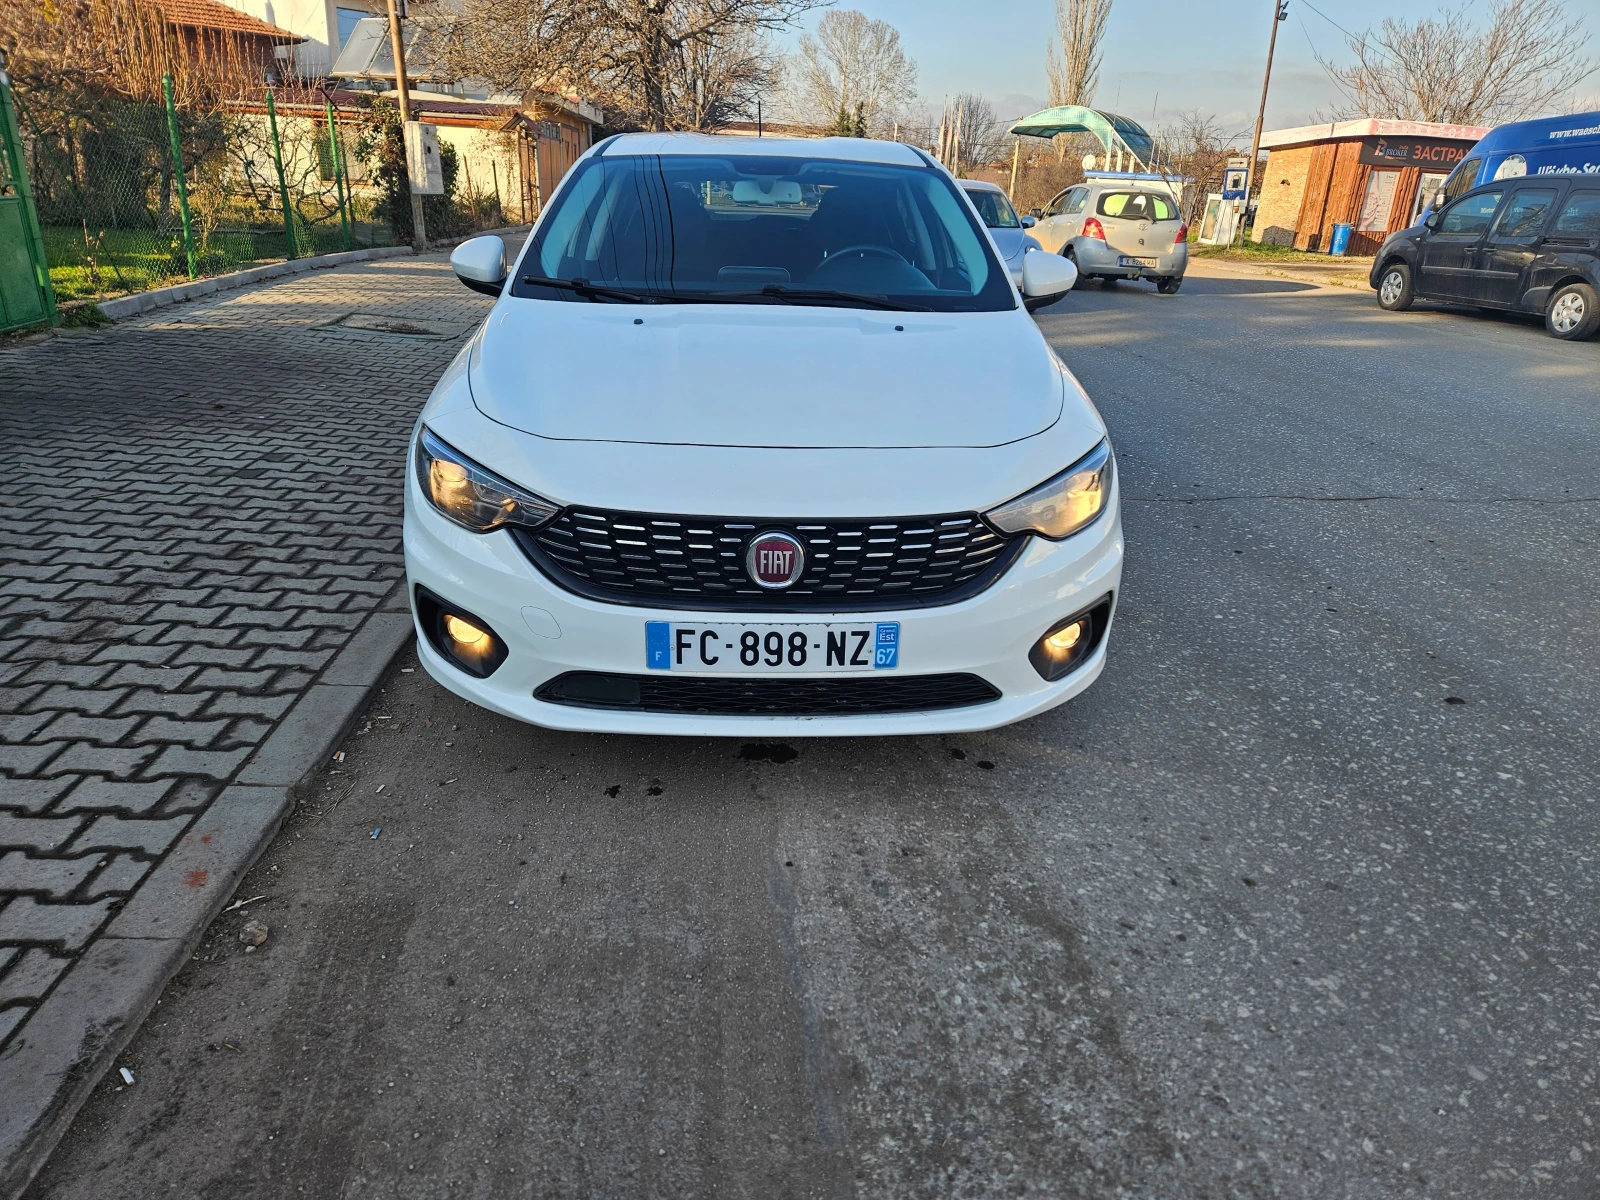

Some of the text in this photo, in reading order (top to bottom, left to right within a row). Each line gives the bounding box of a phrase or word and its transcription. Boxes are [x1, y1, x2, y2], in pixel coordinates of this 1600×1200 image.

[1386, 148, 1408, 157] BROKER
[760, 550, 793, 575] FIAT
[879, 633, 895, 641] Est
[676, 629, 870, 667] FC-898-NZ
[655, 651, 663, 661] F
[876, 647, 896, 665] 67
